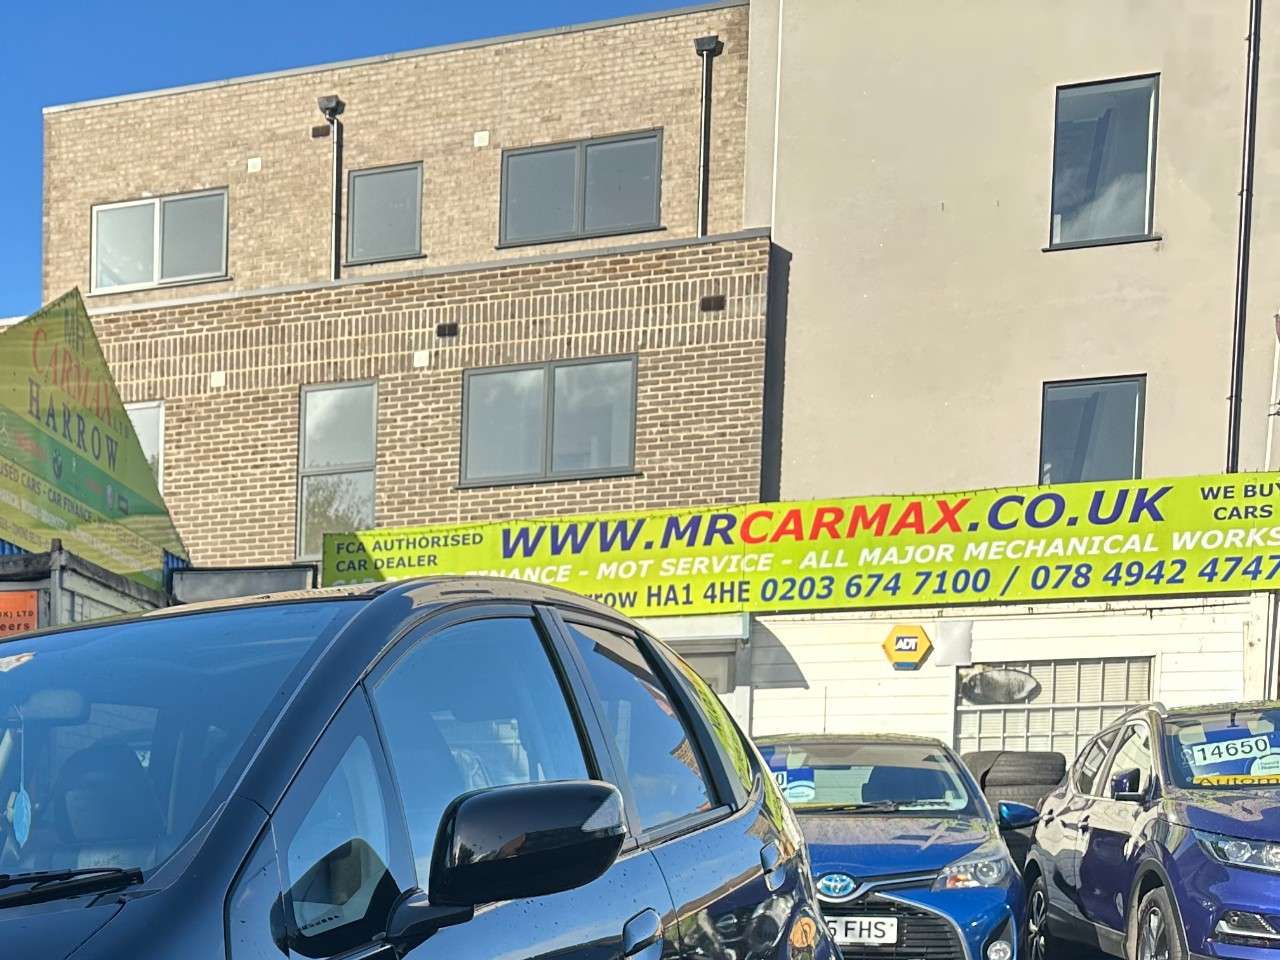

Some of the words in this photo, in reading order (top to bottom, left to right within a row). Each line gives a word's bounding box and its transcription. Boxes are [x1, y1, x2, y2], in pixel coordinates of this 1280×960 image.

[32, 327, 112, 428] CARMAX
[28, 377, 118, 472] HARROW
[21, 473, 41, 496] CARS
[1201, 486, 1235, 500] WE
[502, 486, 1173, 559] WWW.MRCARMAX.CO.UK
[1213, 505, 1273, 520] CARS
[336, 541, 366, 554] FCA
[373, 533, 483, 552] AUTHORISED
[596, 560, 653, 580] MOT
[659, 553, 774, 577] SERVICE
[799, 551, 848, 569] ALL
[858, 544, 954, 566] MAJOR
[963, 533, 1160, 561] MECHANICAL
[1172, 527, 1280, 551] WORKS
[336, 560, 367, 572] CAR
[374, 555, 438, 570] DEALER
[646, 583, 692, 607] HA1
[703, 580, 751, 604] 4HE
[761, 575, 834, 600] 0203
[845, 573, 902, 598] 674
[912, 568, 991, 596] 7100
[999, 565, 1020, 596] /
[1030, 563, 1093, 591] 078
[1103, 559, 1187, 587] 4942
[1198, 554, 1280, 583] 4747
[17, 610, 33, 618] LTD
[896, 638, 918, 650] ADT
[1197, 738, 1268, 761] 14650
[844, 921, 886, 938] FHS
